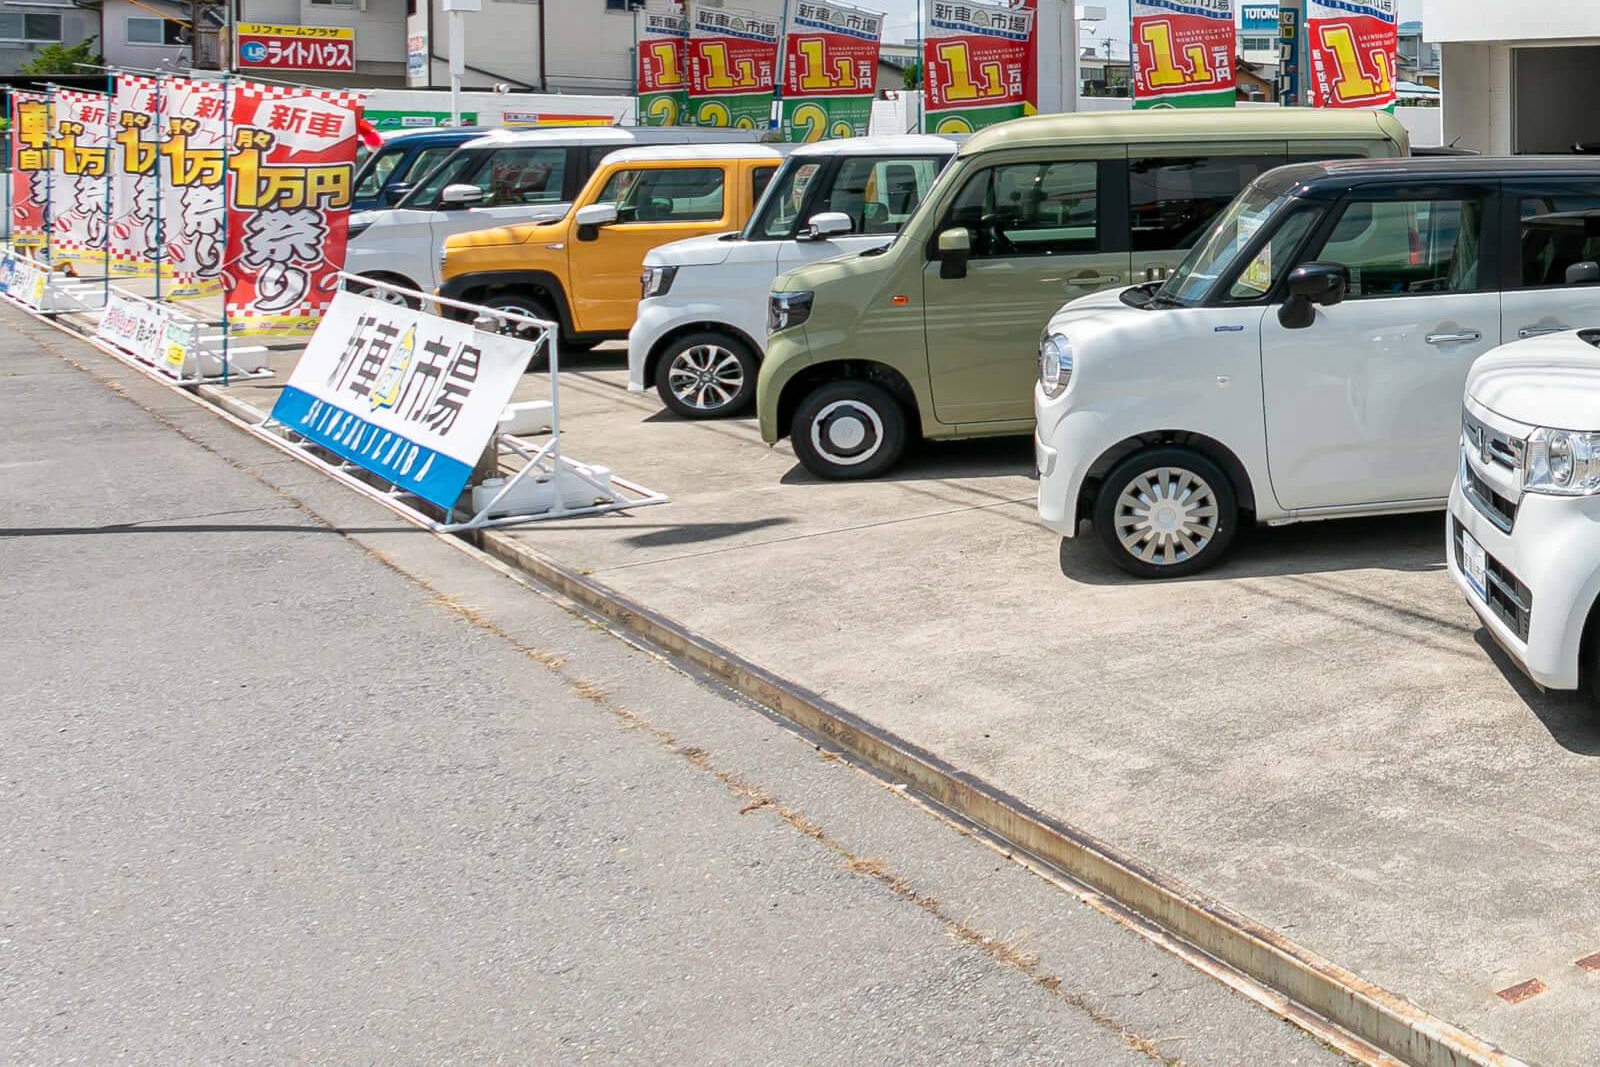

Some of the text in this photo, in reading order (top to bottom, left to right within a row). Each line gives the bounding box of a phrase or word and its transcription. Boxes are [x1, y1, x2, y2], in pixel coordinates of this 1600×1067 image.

[699, 9, 776, 36] 新車市場
[799, 3, 877, 34] 新車市場
[934, 2, 1027, 33] 新車市場
[1244, 7, 1279, 20] TOTOKU
[250, 25, 340, 37] リフォームプラザ
[268, 40, 352, 67] ライトハウス
[701, 42, 757, 89] 1.1
[799, 39, 856, 89] 1.1
[1142, 22, 1213, 88] 1.1
[1212, 51, 1232, 83] 万円
[1320, 25, 1391, 101] 1.1
[939, 42, 1006, 101] 1.1
[1007, 69, 1023, 97] 万円
[59, 120, 85, 136] 月々
[120, 111, 150, 128] 月々
[169, 118, 199, 136] 月々
[266, 103, 345, 139] 新車
[235, 129, 271, 149] 月々
[228, 149, 351, 209] 1万円
[244, 209, 329, 312] 祭り
